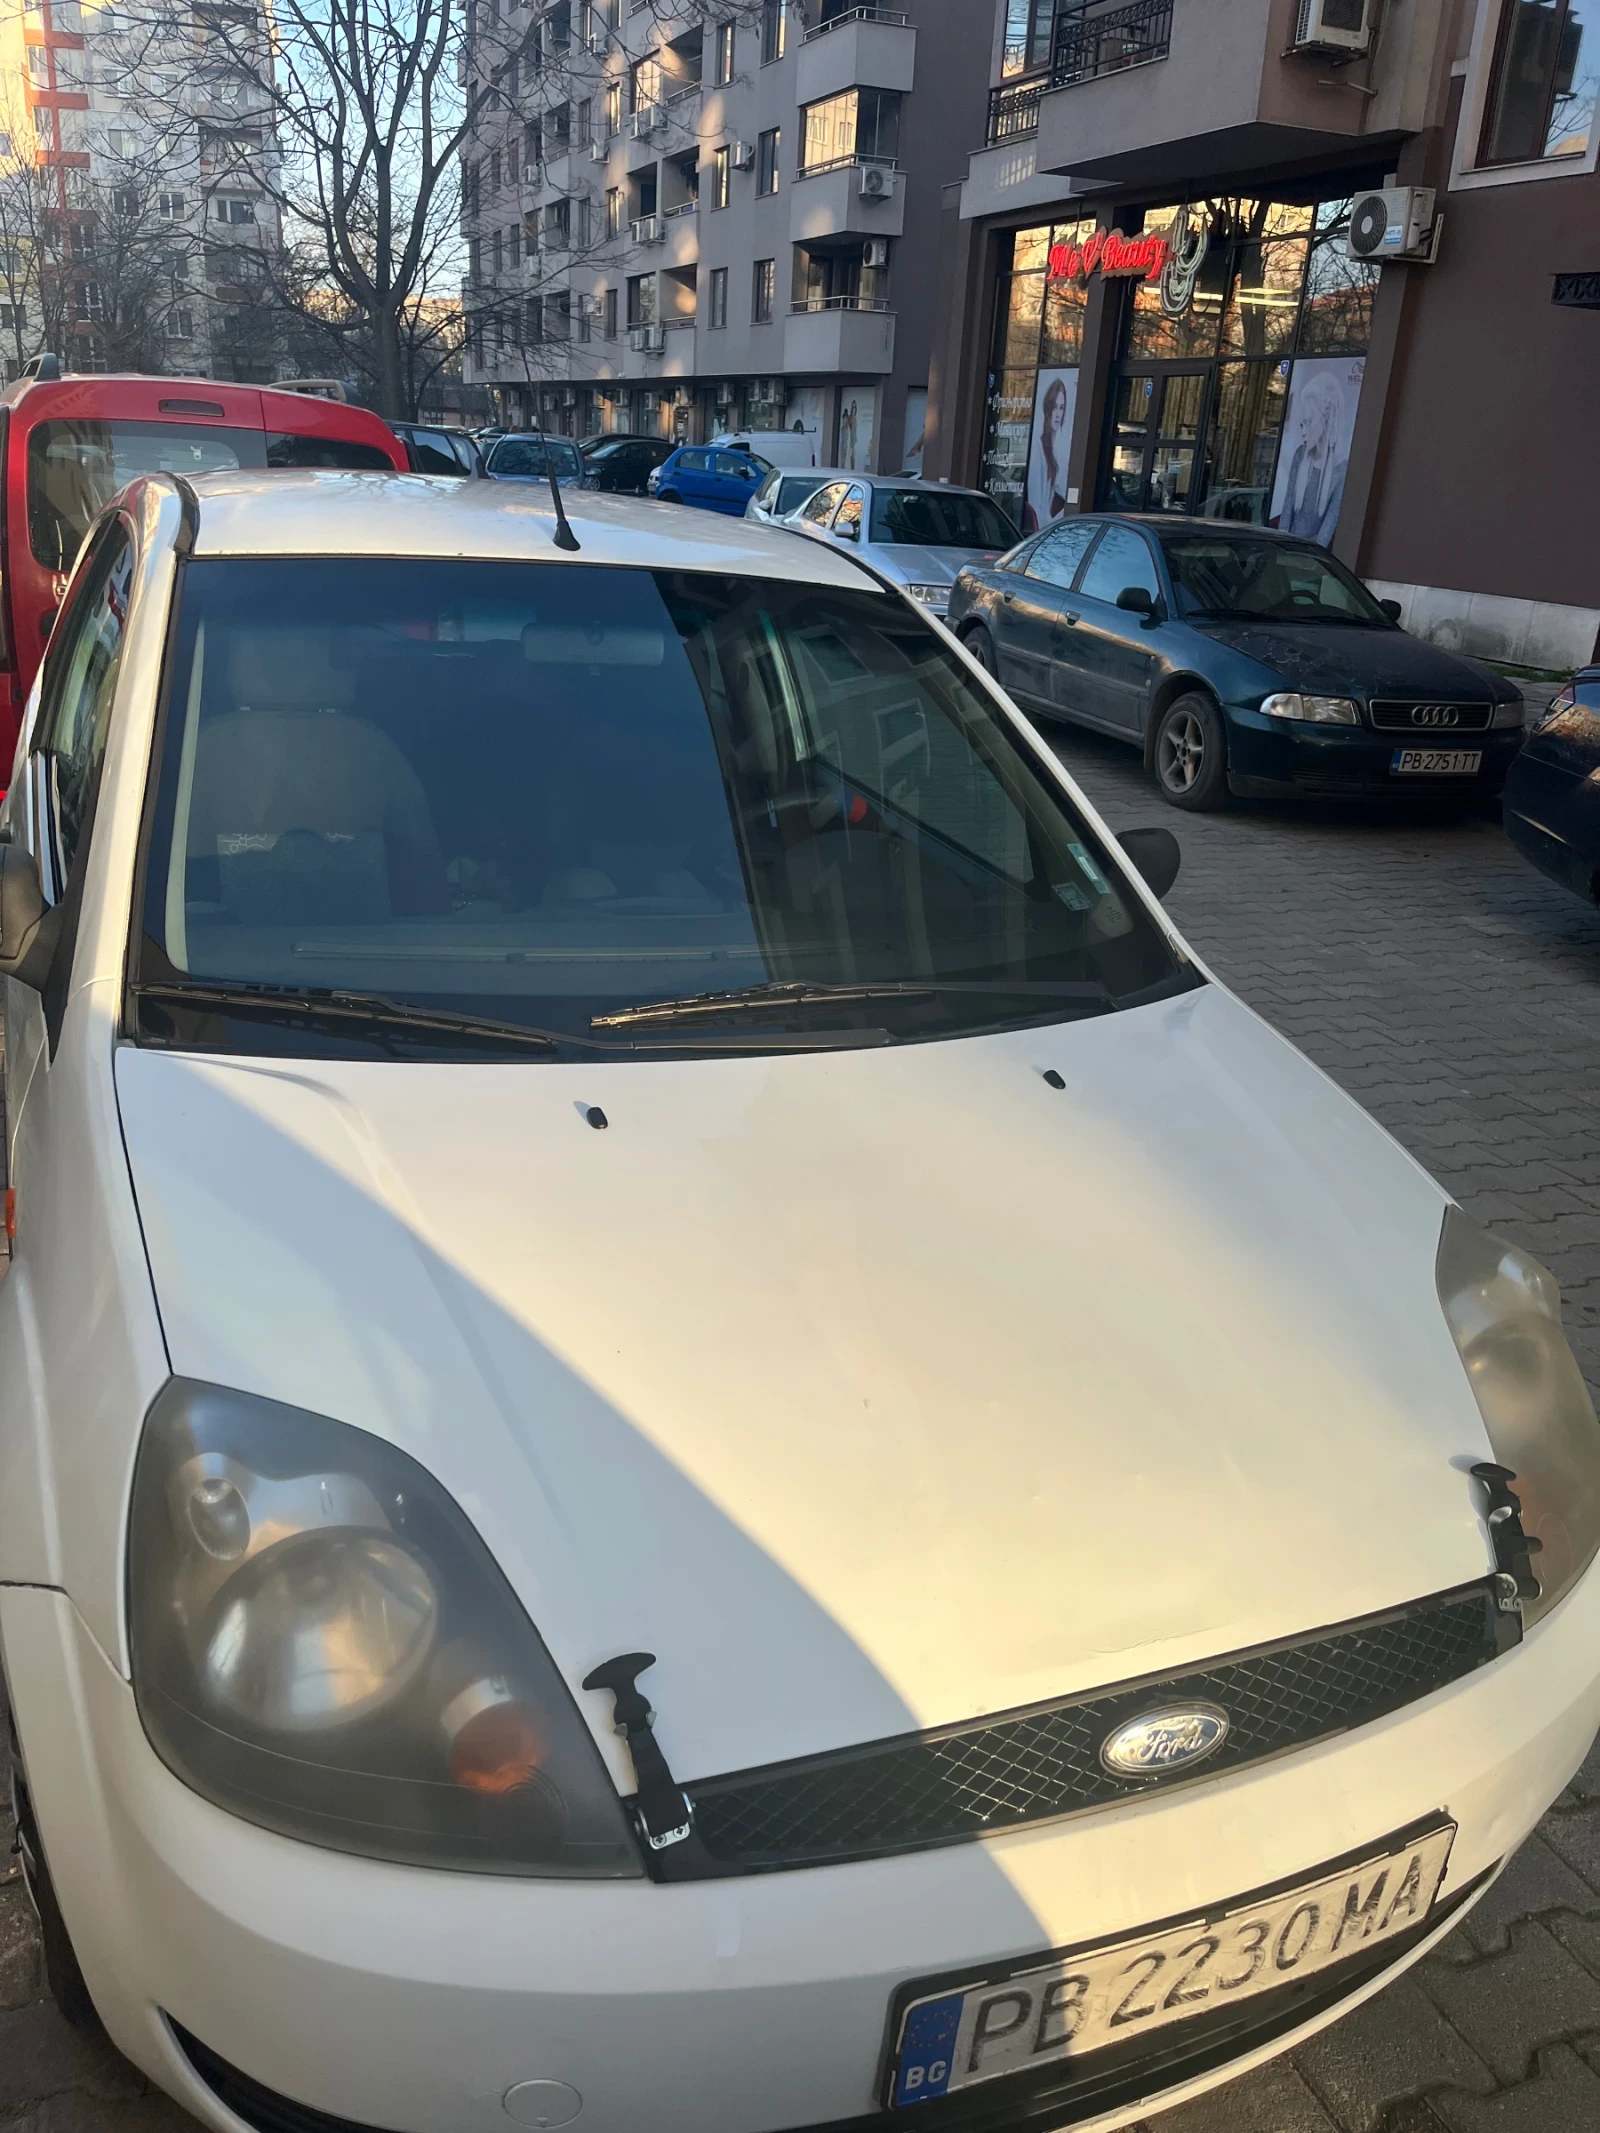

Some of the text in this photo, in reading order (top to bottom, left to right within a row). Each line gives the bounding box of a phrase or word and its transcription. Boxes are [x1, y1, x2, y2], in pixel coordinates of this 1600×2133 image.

[1101, 234, 1168, 280] Beauty
[1137, 1719, 1203, 1763] Ford
[905, 2060, 947, 2090] BG
